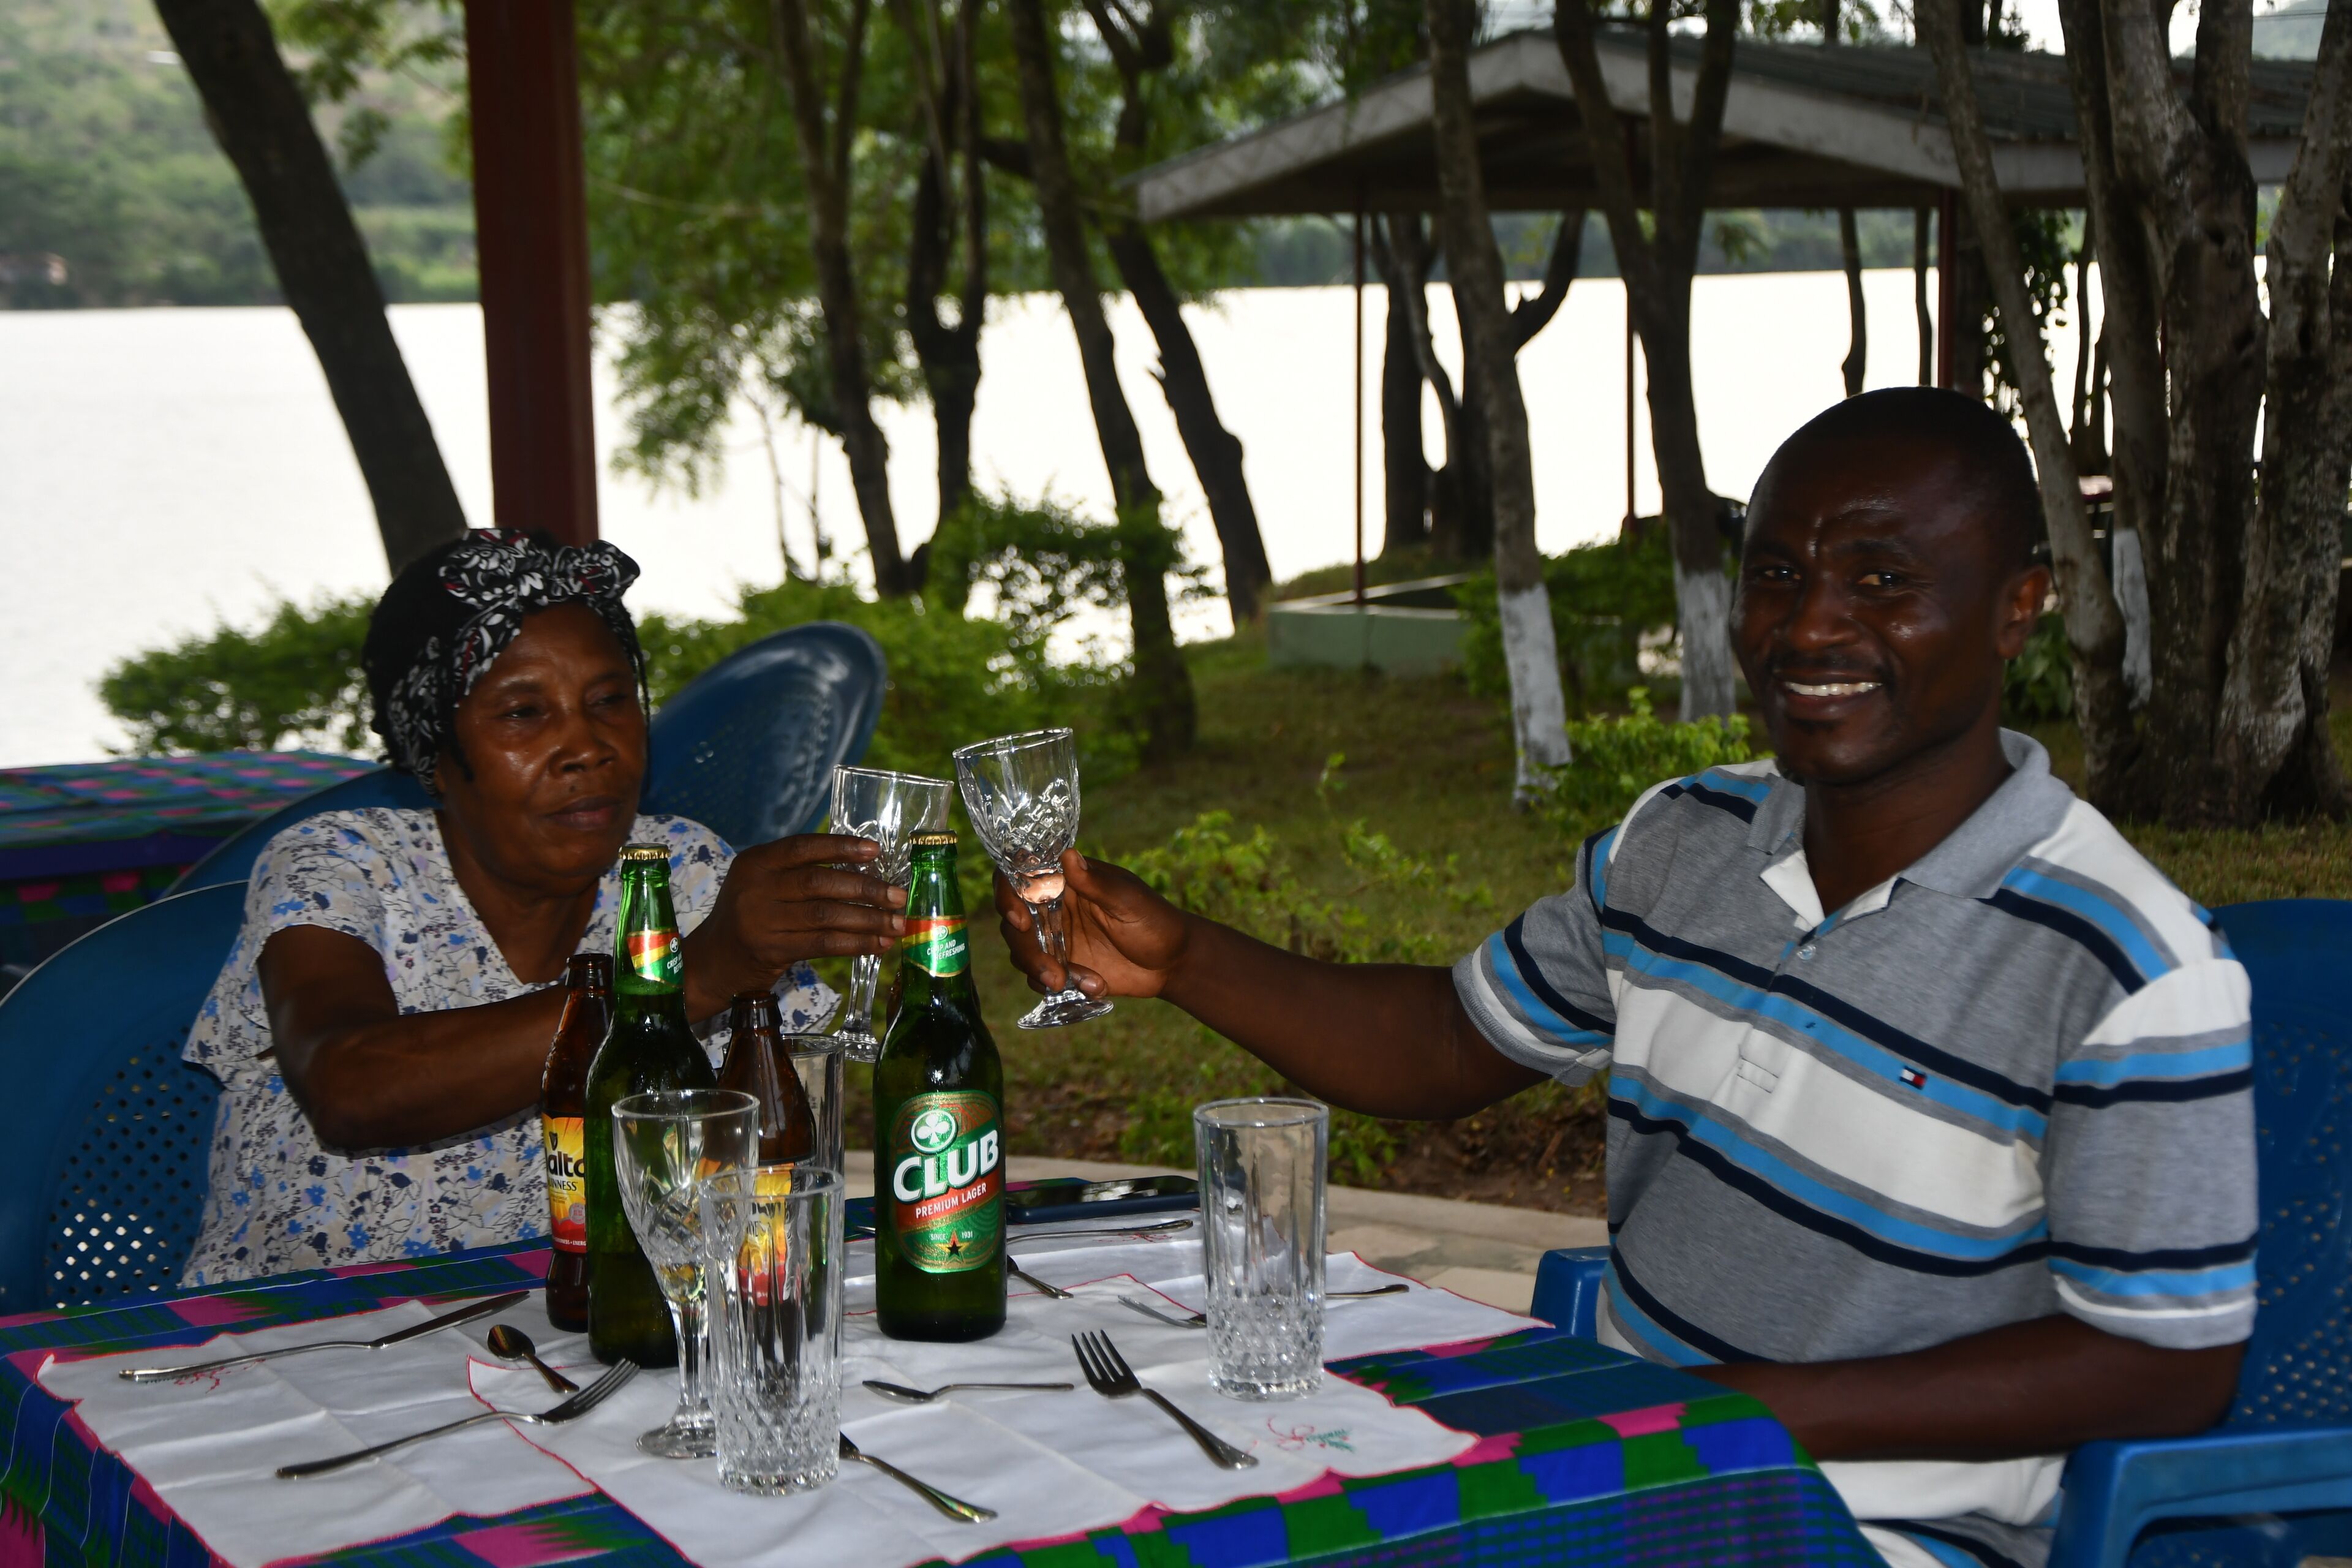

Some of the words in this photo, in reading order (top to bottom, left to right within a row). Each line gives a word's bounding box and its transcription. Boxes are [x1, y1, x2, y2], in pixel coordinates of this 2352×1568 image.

[935, 943, 965, 960] REFRESHING
[945, 940, 956, 949] AND
[667, 957, 677, 969] CRISP
[893, 1129, 999, 1202] CLUB
[549, 1178, 578, 1191] NNESS
[916, 1196, 959, 1219] PREMIUM
[962, 1183, 987, 1204] LAGER
